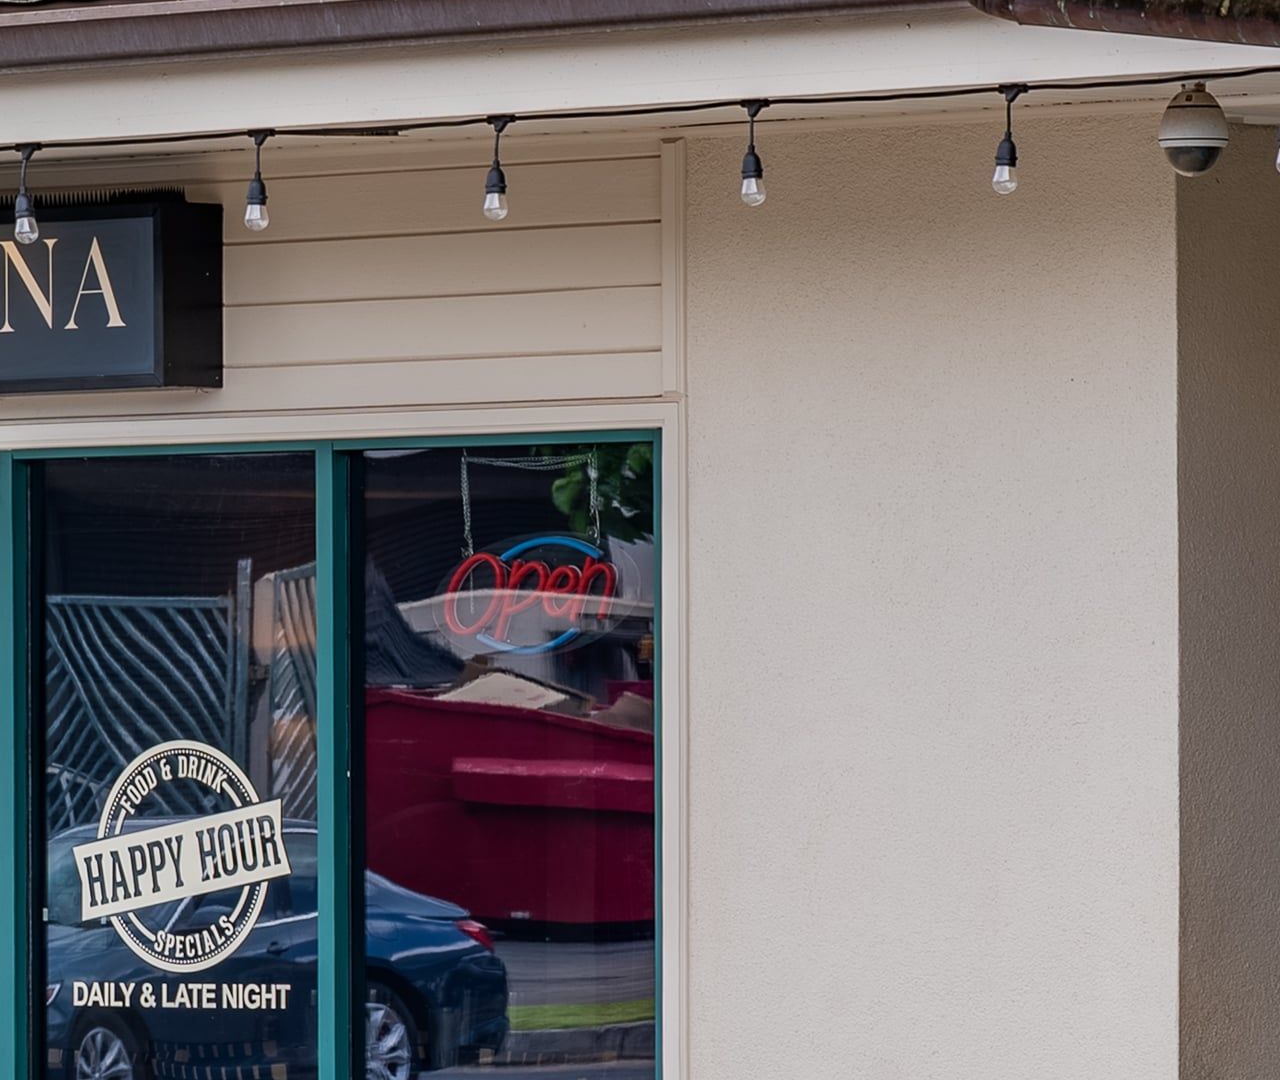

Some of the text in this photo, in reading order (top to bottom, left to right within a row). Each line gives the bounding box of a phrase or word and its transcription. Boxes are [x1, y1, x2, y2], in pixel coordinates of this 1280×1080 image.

[444, 551, 618, 641] Open
[119, 755, 227, 816] FOOD & DRINK
[83, 814, 282, 908] HAPPY HOUR
[153, 914, 235, 958] SPECIALS
[72, 981, 292, 1010] DAILY & LATE NIGHT
